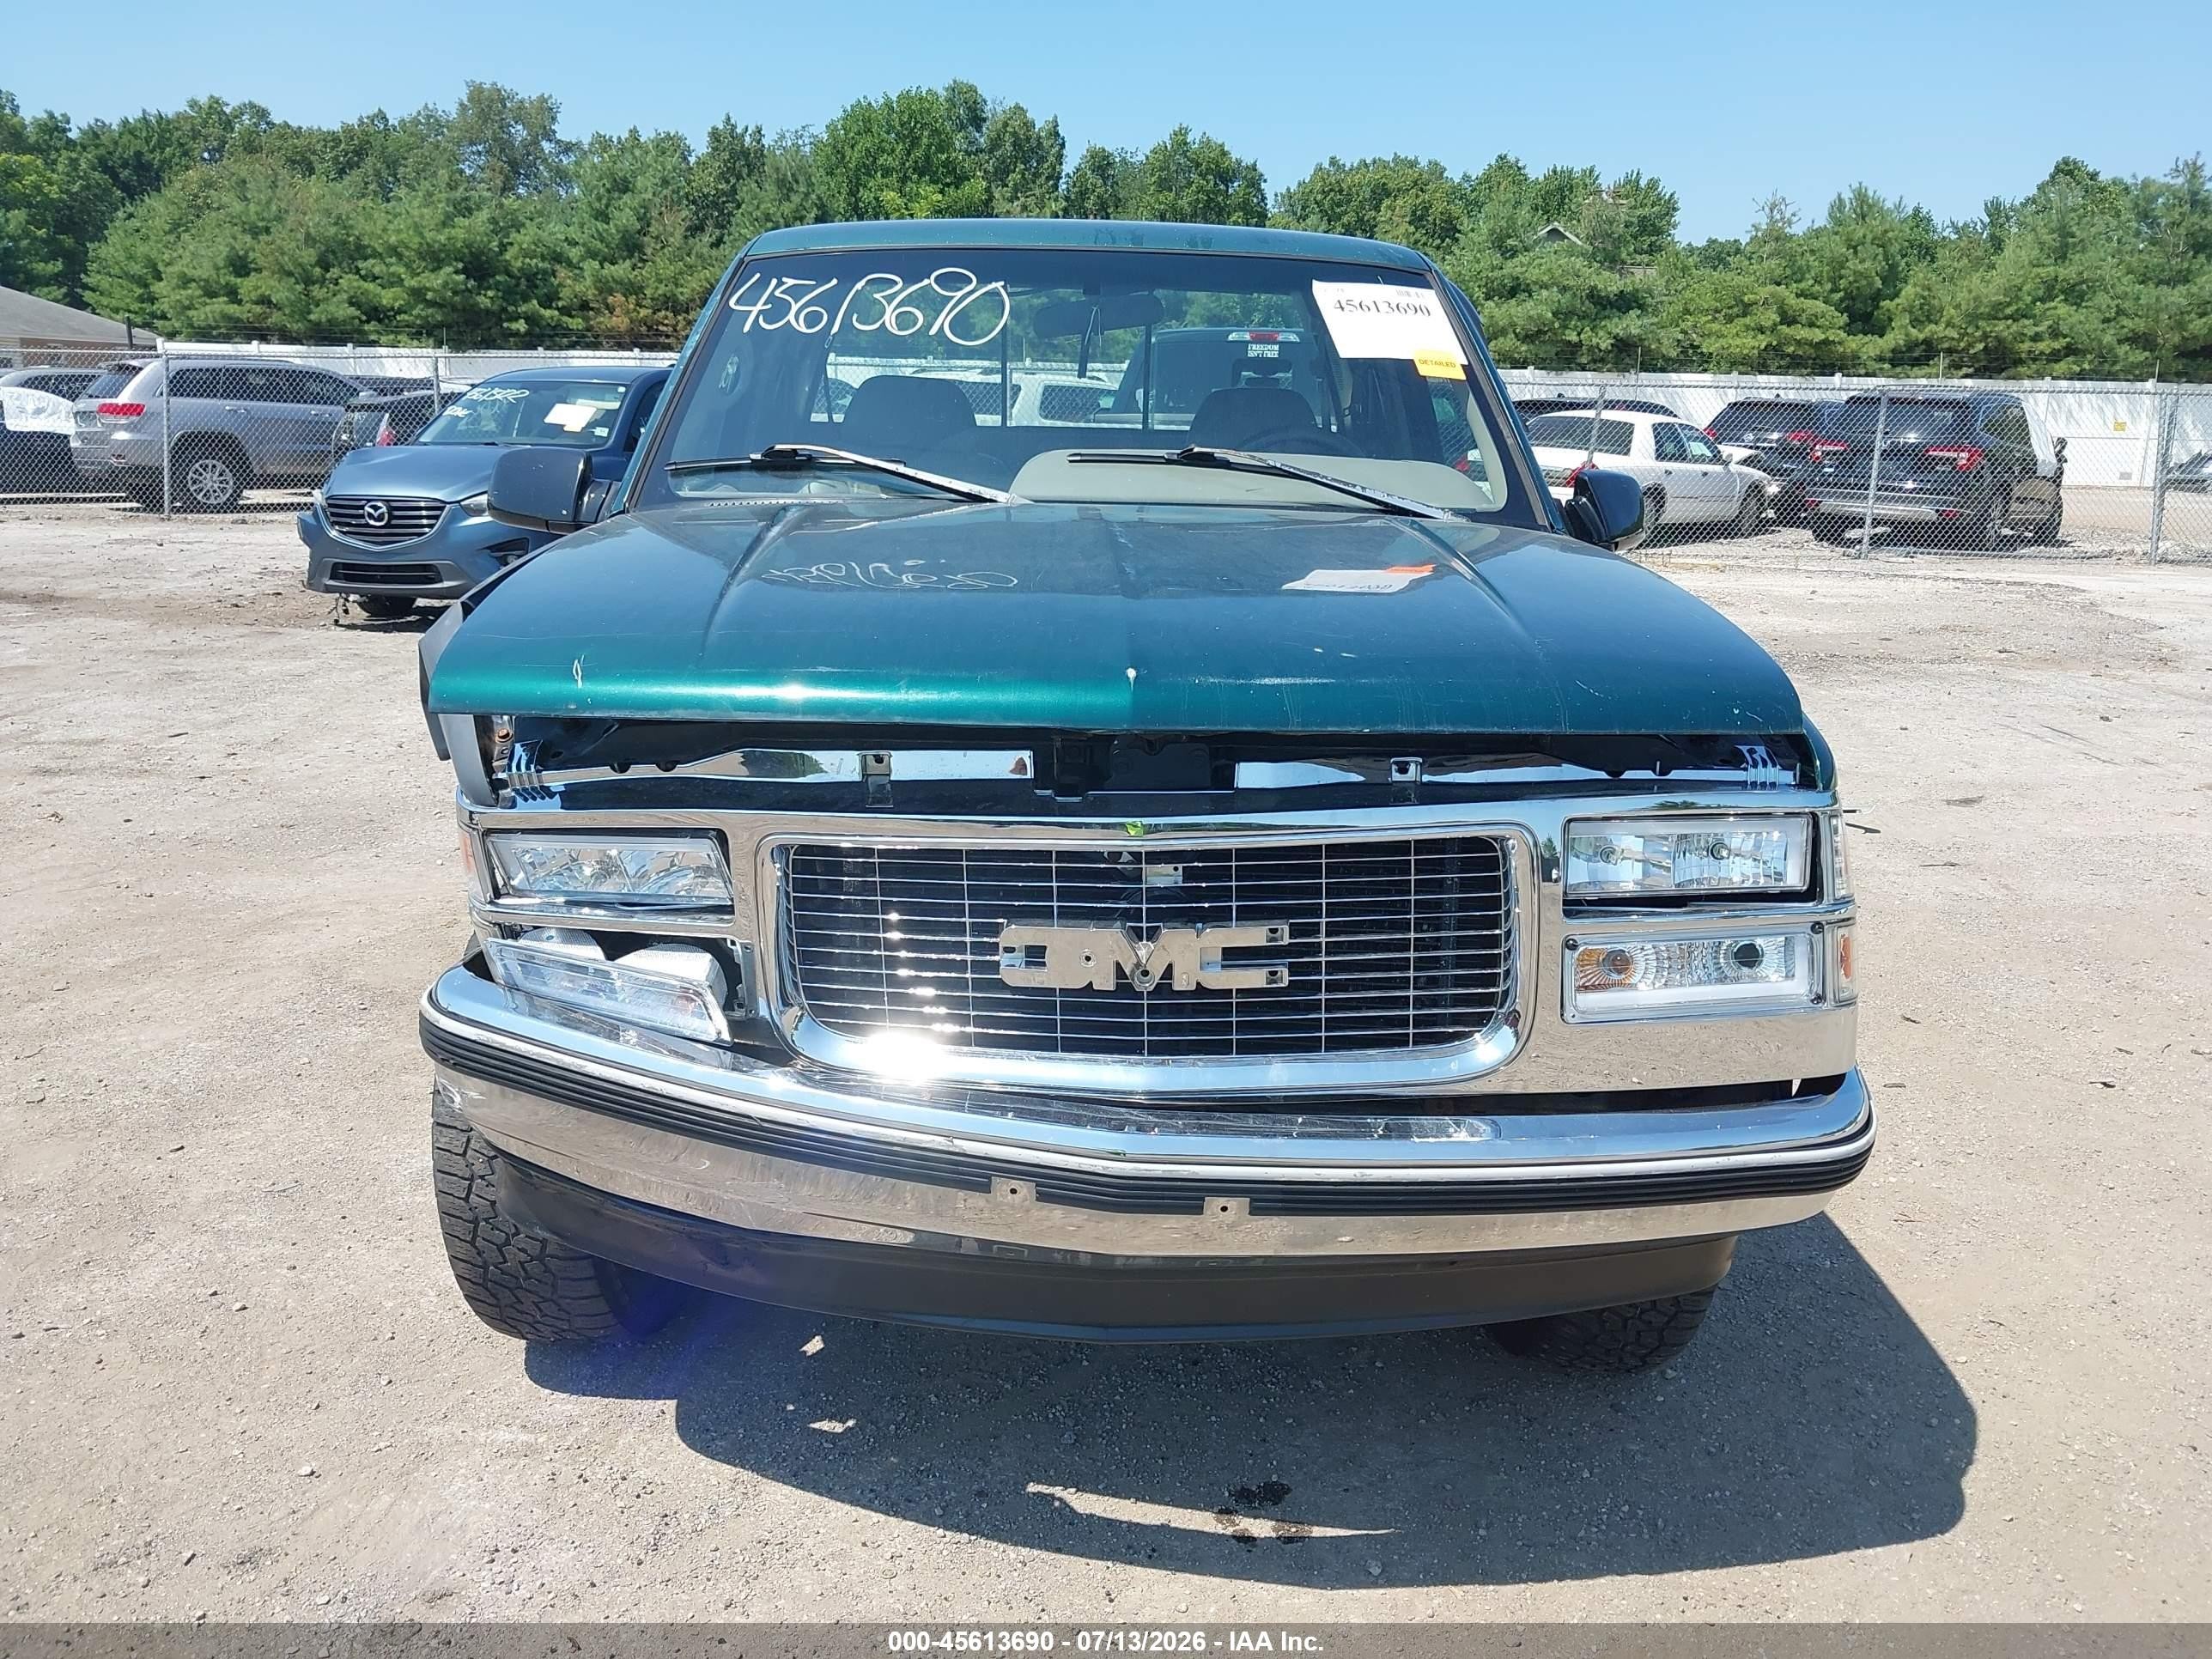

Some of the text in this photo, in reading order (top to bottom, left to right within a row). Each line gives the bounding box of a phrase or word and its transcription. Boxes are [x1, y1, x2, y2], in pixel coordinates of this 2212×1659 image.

[728, 266, 1011, 346] 45613690
[1334, 299, 1431, 317] 45613690
[1418, 358, 1456, 368] DETAILED
[999, 925, 1289, 992] GMC
